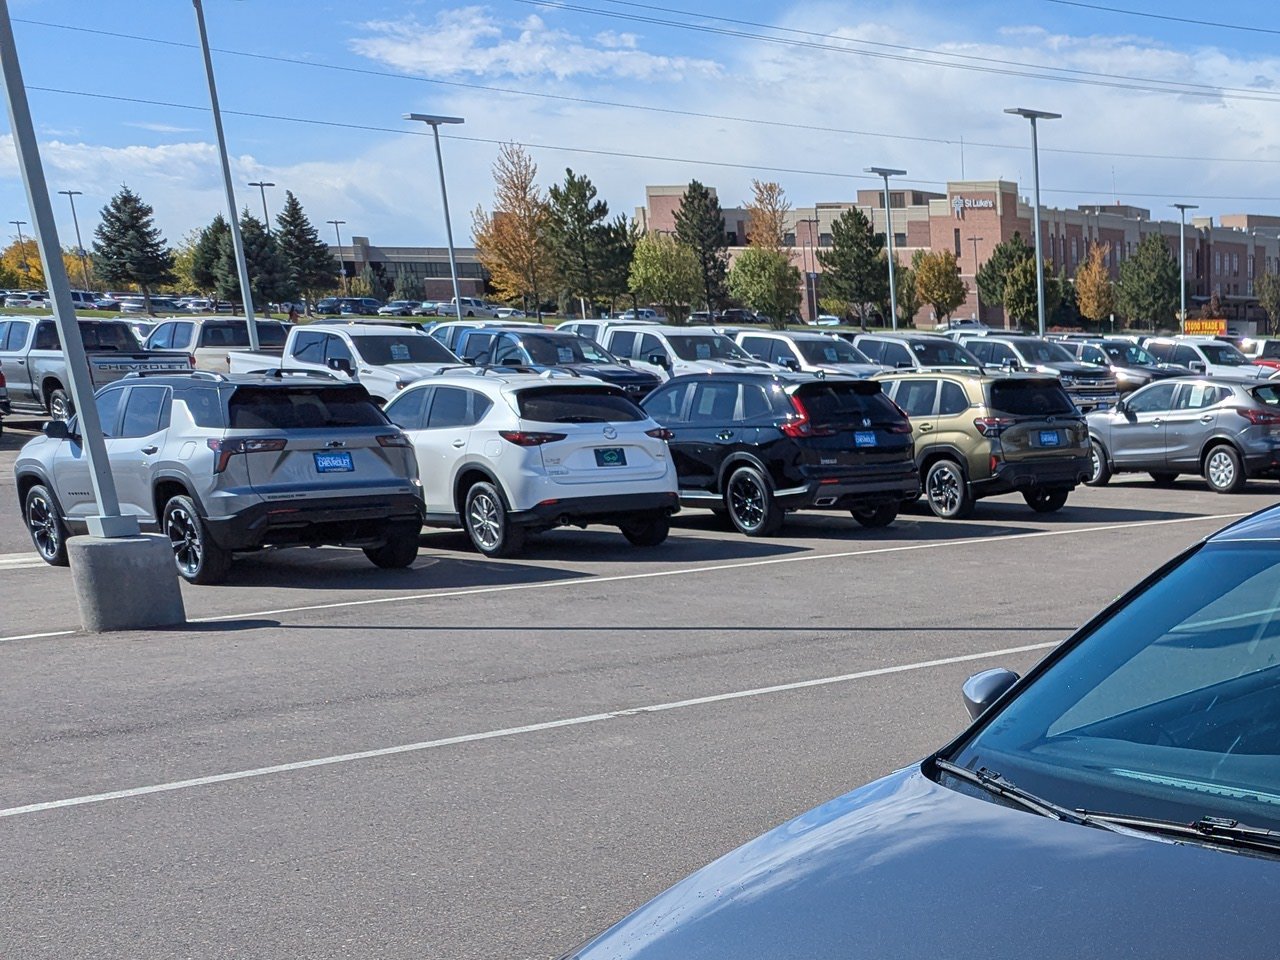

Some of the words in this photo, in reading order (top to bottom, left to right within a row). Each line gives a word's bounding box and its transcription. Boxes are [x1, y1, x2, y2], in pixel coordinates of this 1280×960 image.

[973, 199, 993, 208] Luke's
[1202, 321, 1218, 331] TRADE
[1218, 321, 1225, 330] IN
